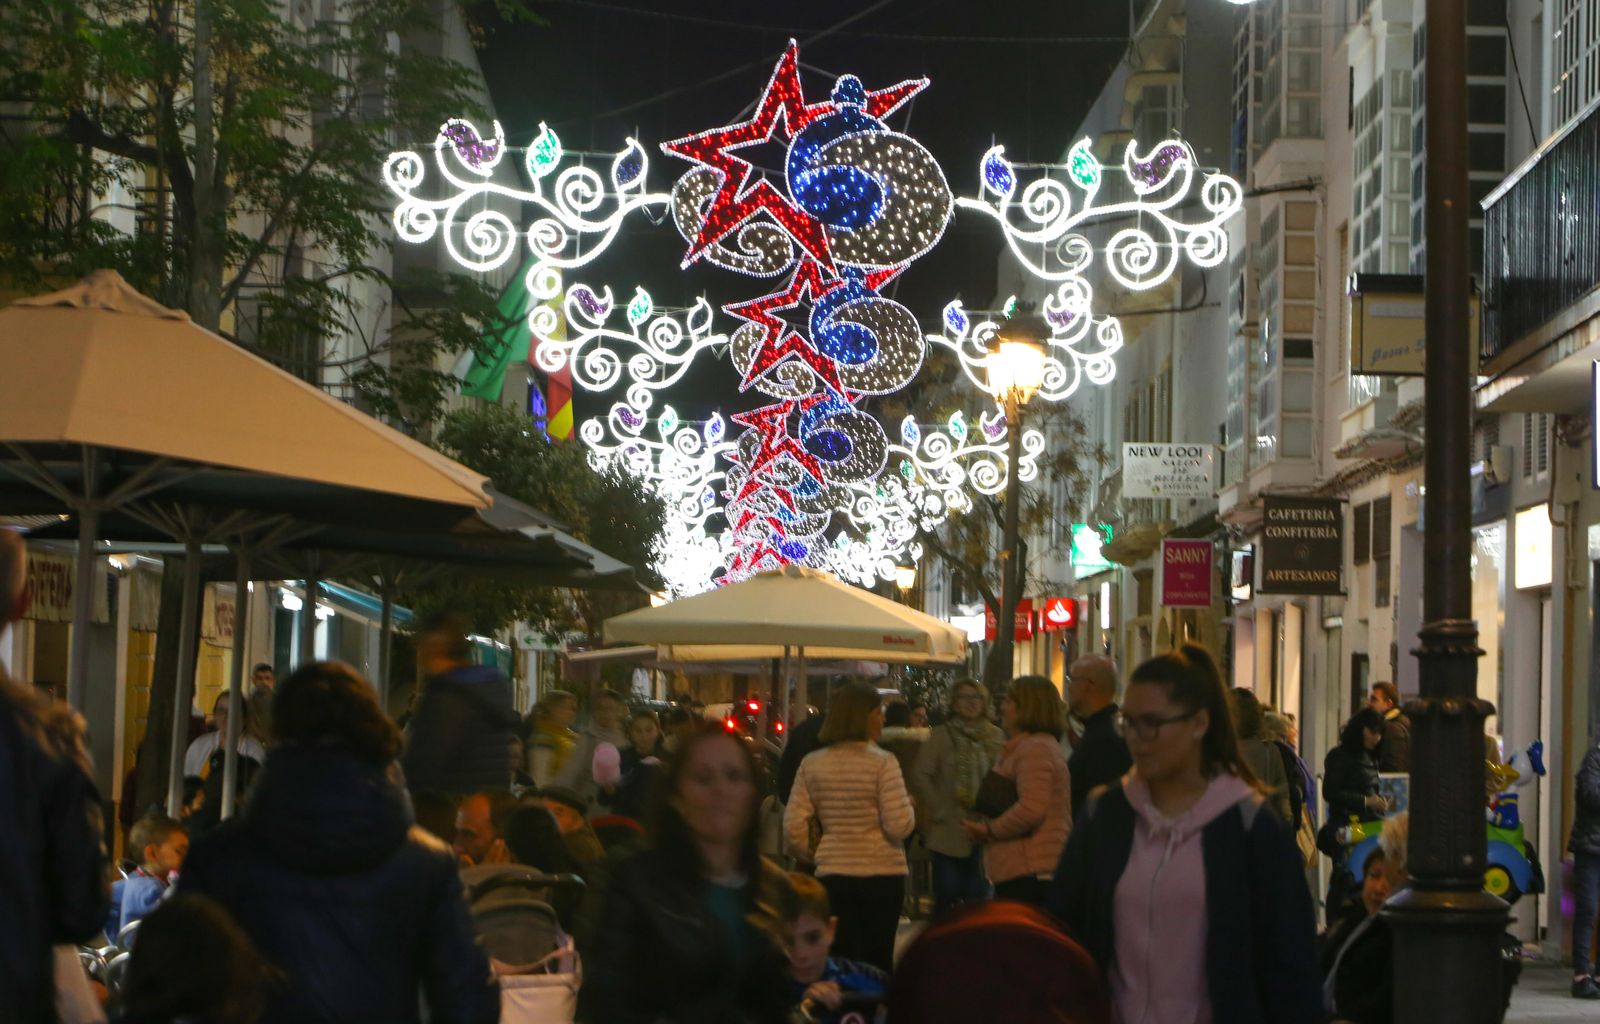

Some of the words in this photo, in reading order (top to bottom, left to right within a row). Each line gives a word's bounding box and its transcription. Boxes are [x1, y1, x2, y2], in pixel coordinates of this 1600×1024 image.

[1128, 446, 1163, 457] NEW
[1268, 506, 1335, 521] CAFETERÍA
[1265, 525, 1338, 539] CONFITERÍA
[1166, 547, 1209, 564] SANNY
[1265, 568, 1338, 582] ARTESANOS
